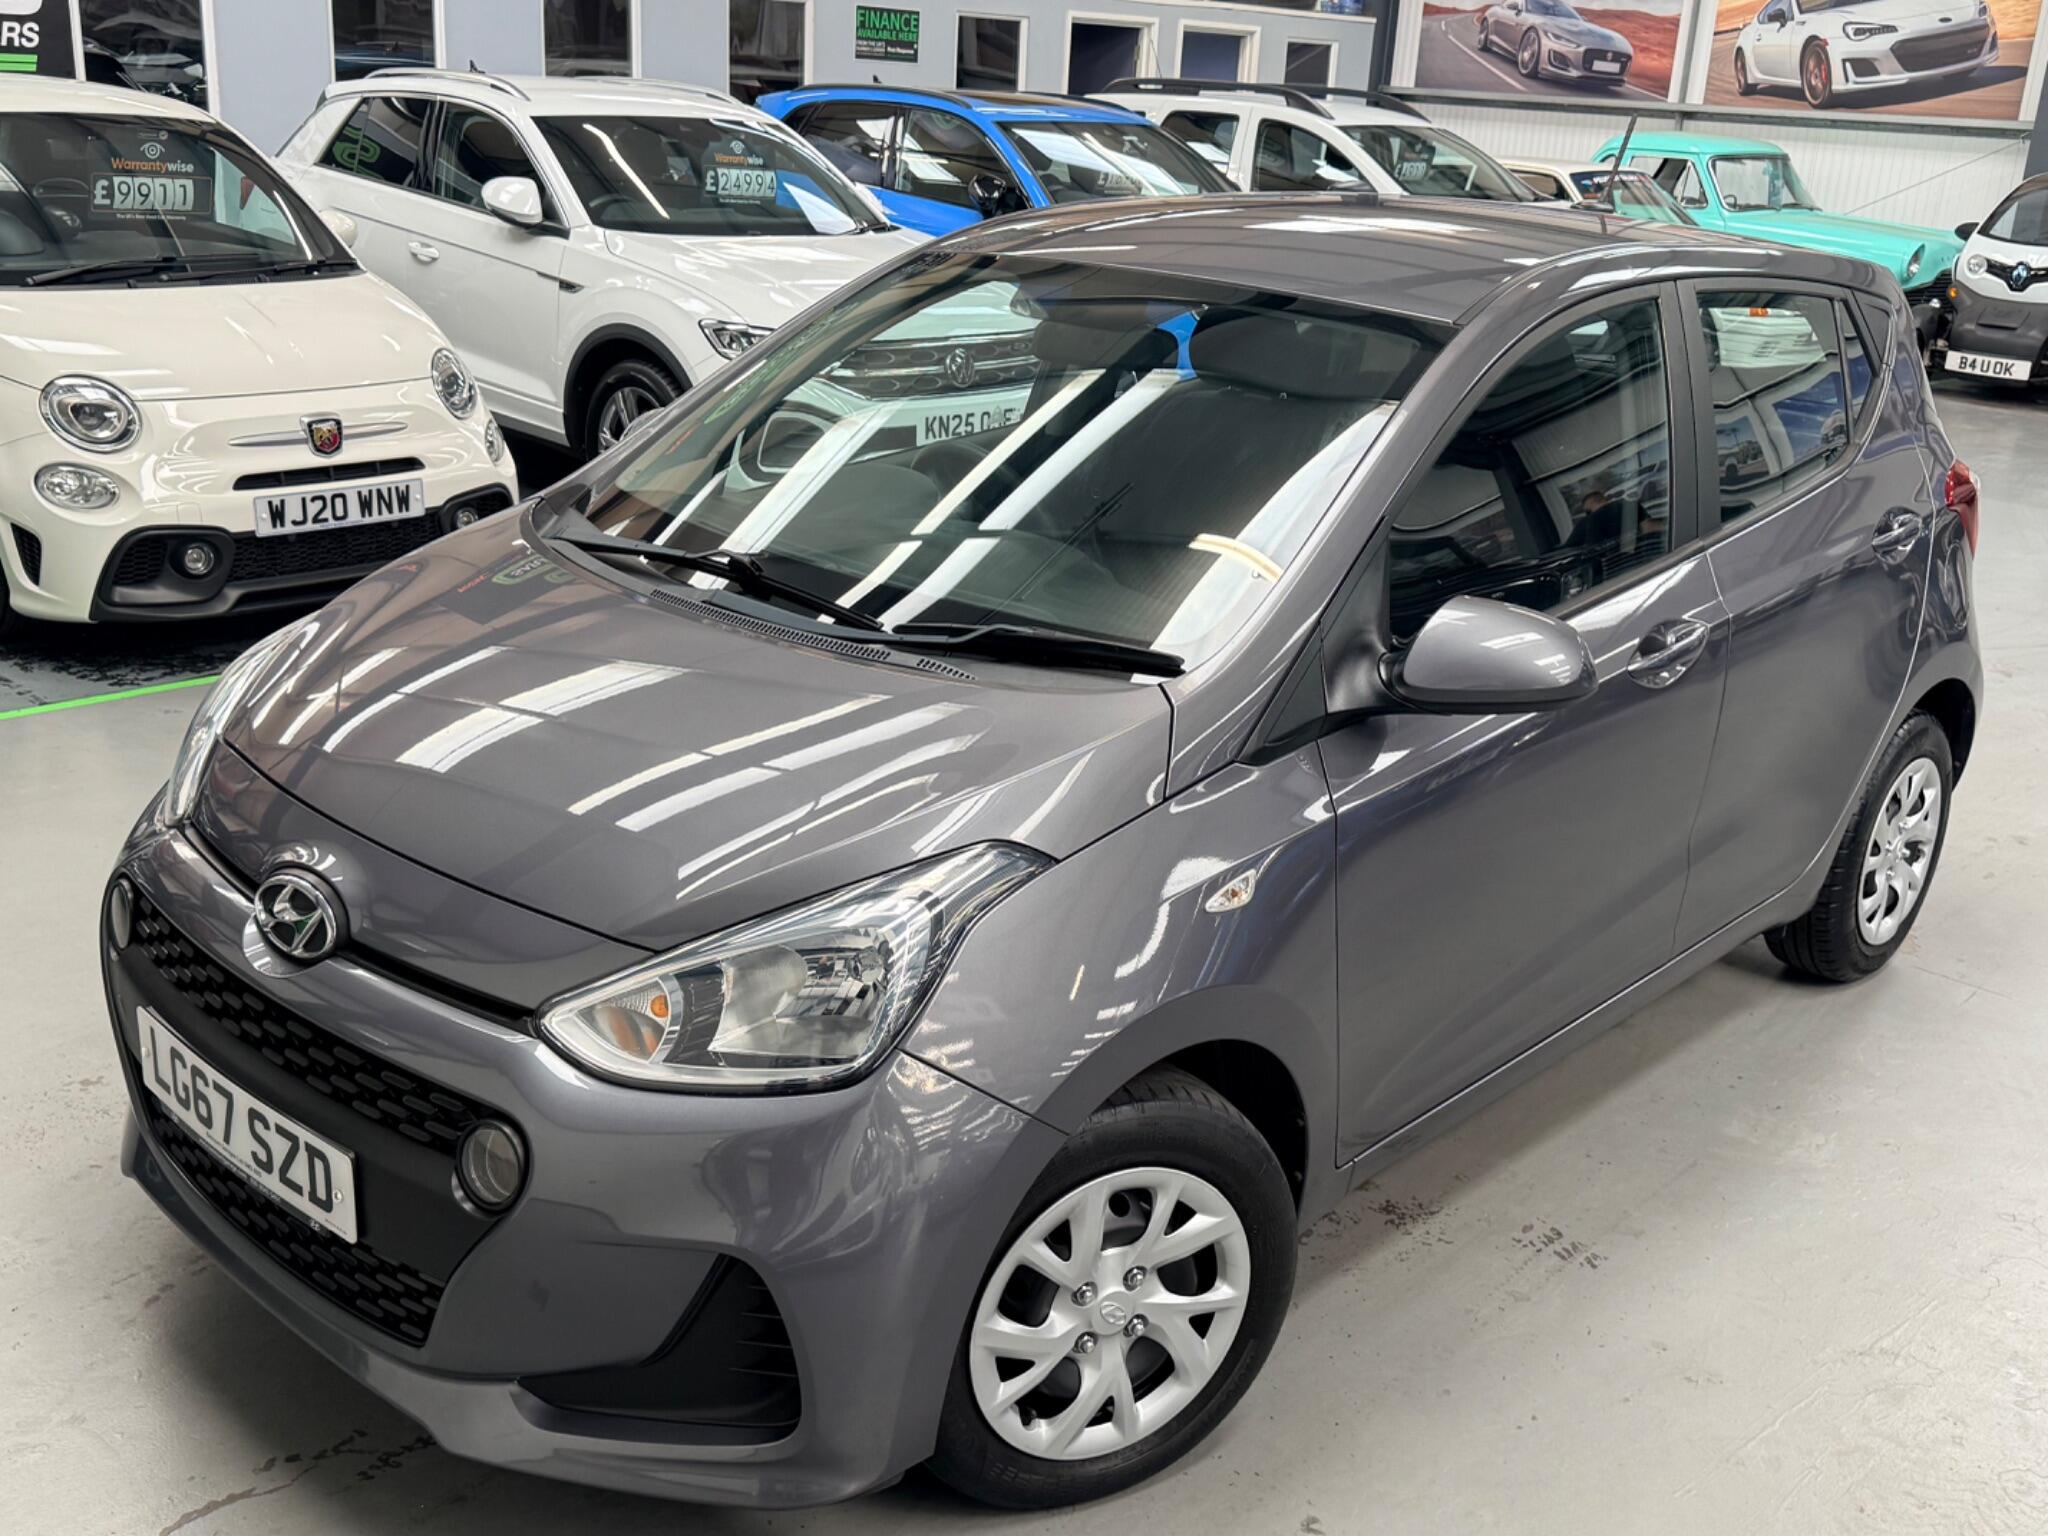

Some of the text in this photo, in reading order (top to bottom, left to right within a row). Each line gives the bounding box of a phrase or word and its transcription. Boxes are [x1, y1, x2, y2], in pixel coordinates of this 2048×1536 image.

[857, 9, 919, 32] FINANCE
[0, 21, 40, 48] RS
[857, 28, 918, 42] AVAILABLE HERE
[111, 157, 195, 174] Warrantywise
[1958, 356, 2015, 376] B4 U OK
[924, 412, 976, 440] KN25
[267, 484, 410, 530] WJ20 WNW
[150, 1024, 235, 1146] LG67
[247, 1106, 334, 1214] SZD
